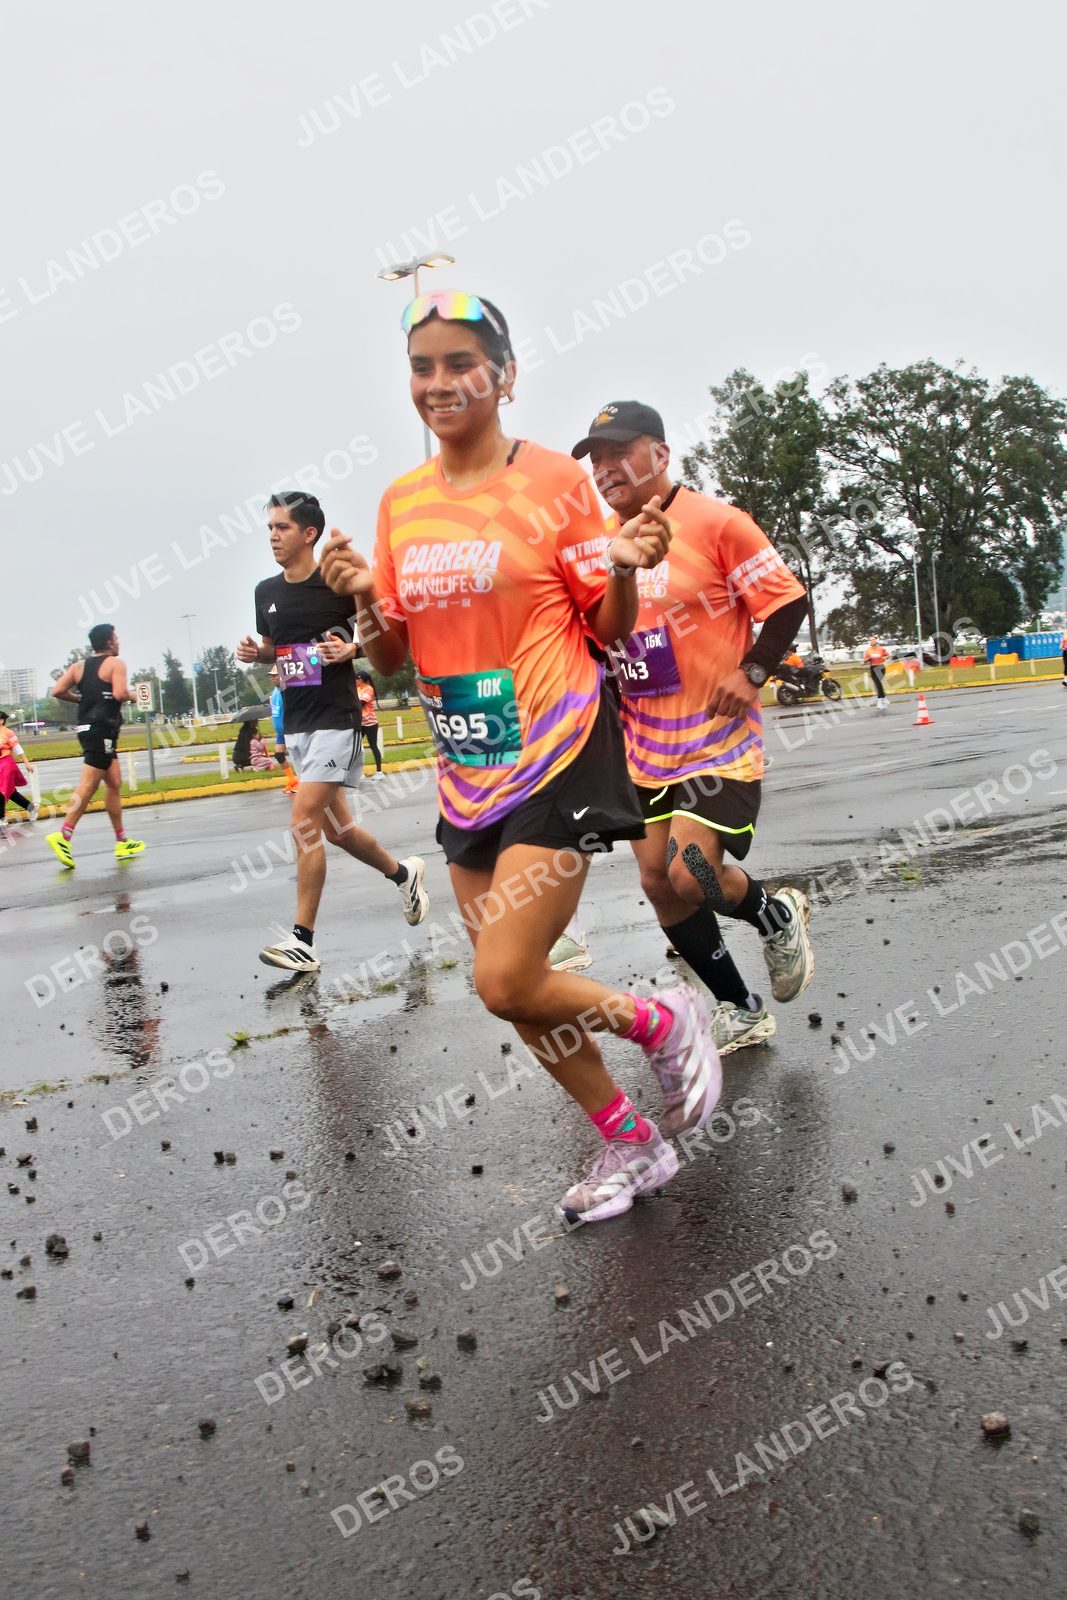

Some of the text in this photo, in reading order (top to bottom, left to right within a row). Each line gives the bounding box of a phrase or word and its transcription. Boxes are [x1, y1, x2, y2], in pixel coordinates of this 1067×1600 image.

[401, 540, 502, 574] CARRERA
[400, 574, 468, 597] OMNILIFE
[644, 633, 662, 649] 15K
[283, 661, 304, 675] 132
[620, 661, 649, 680] 143
[476, 677, 502, 698] 10K
[428, 711, 488, 740] 1695
